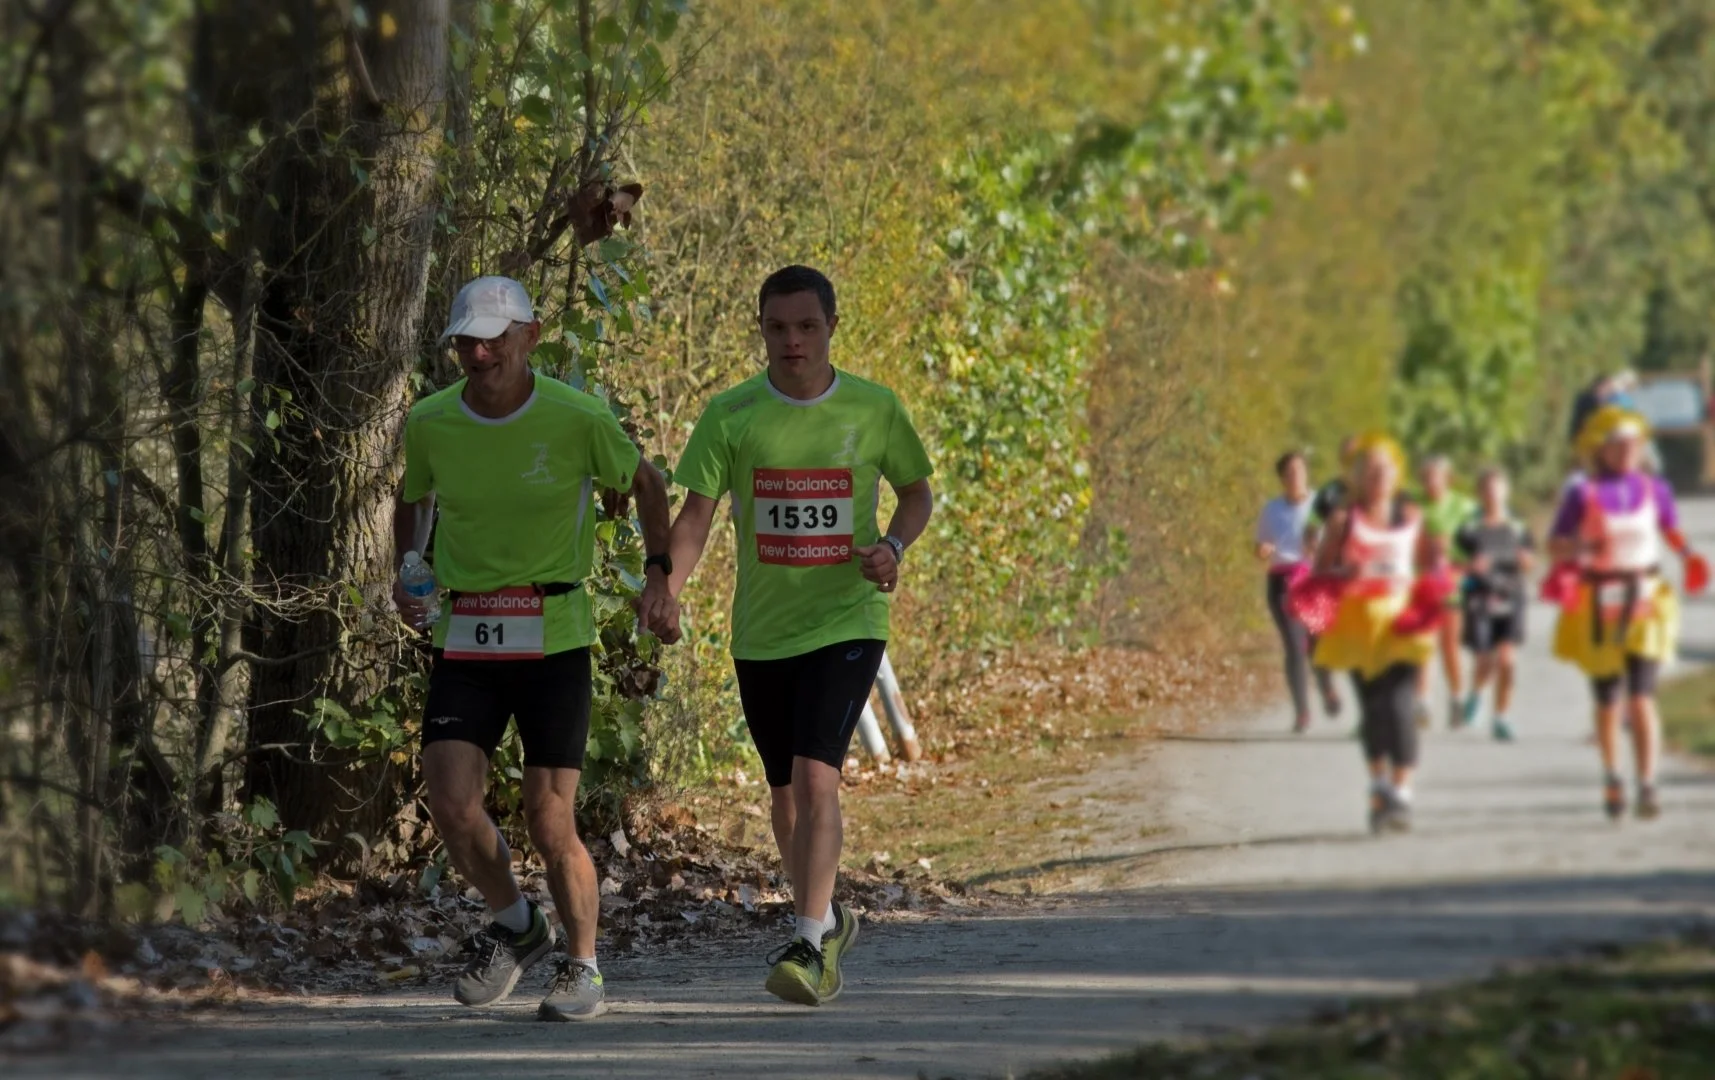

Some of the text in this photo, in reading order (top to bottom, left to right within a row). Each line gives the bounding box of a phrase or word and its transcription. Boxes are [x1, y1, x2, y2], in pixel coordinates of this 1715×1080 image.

[756, 477, 848, 491] new balance
[768, 504, 838, 529] 1539
[760, 544, 849, 558] new balance
[456, 594, 540, 609] new balance
[475, 622, 504, 645] 61
